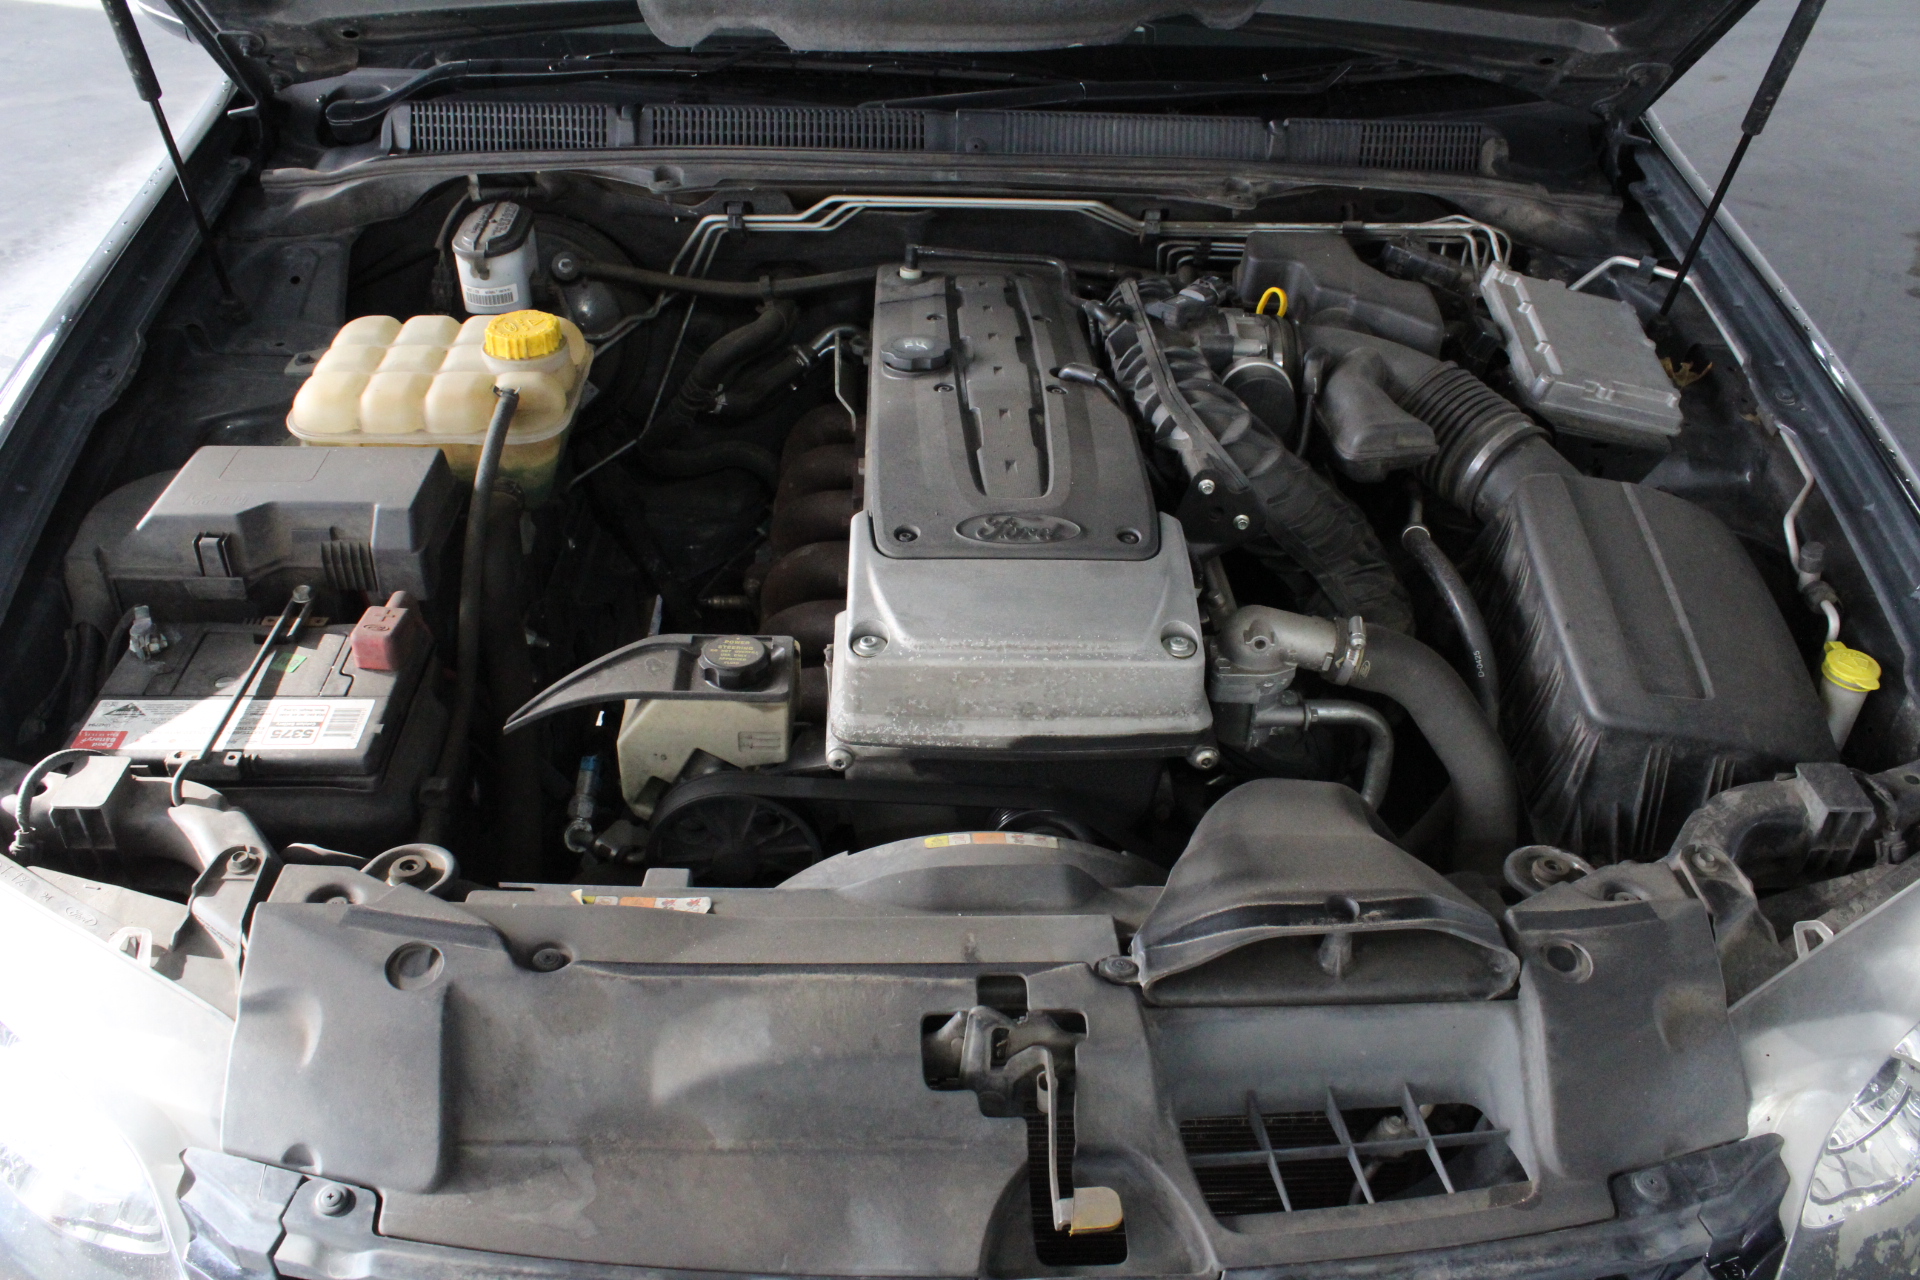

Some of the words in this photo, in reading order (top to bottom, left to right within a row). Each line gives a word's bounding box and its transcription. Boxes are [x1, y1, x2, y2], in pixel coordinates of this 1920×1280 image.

[976, 516, 1064, 541] Ford
[1473, 650, 1485, 678] D-0425
[270, 729, 315, 739] 5375
